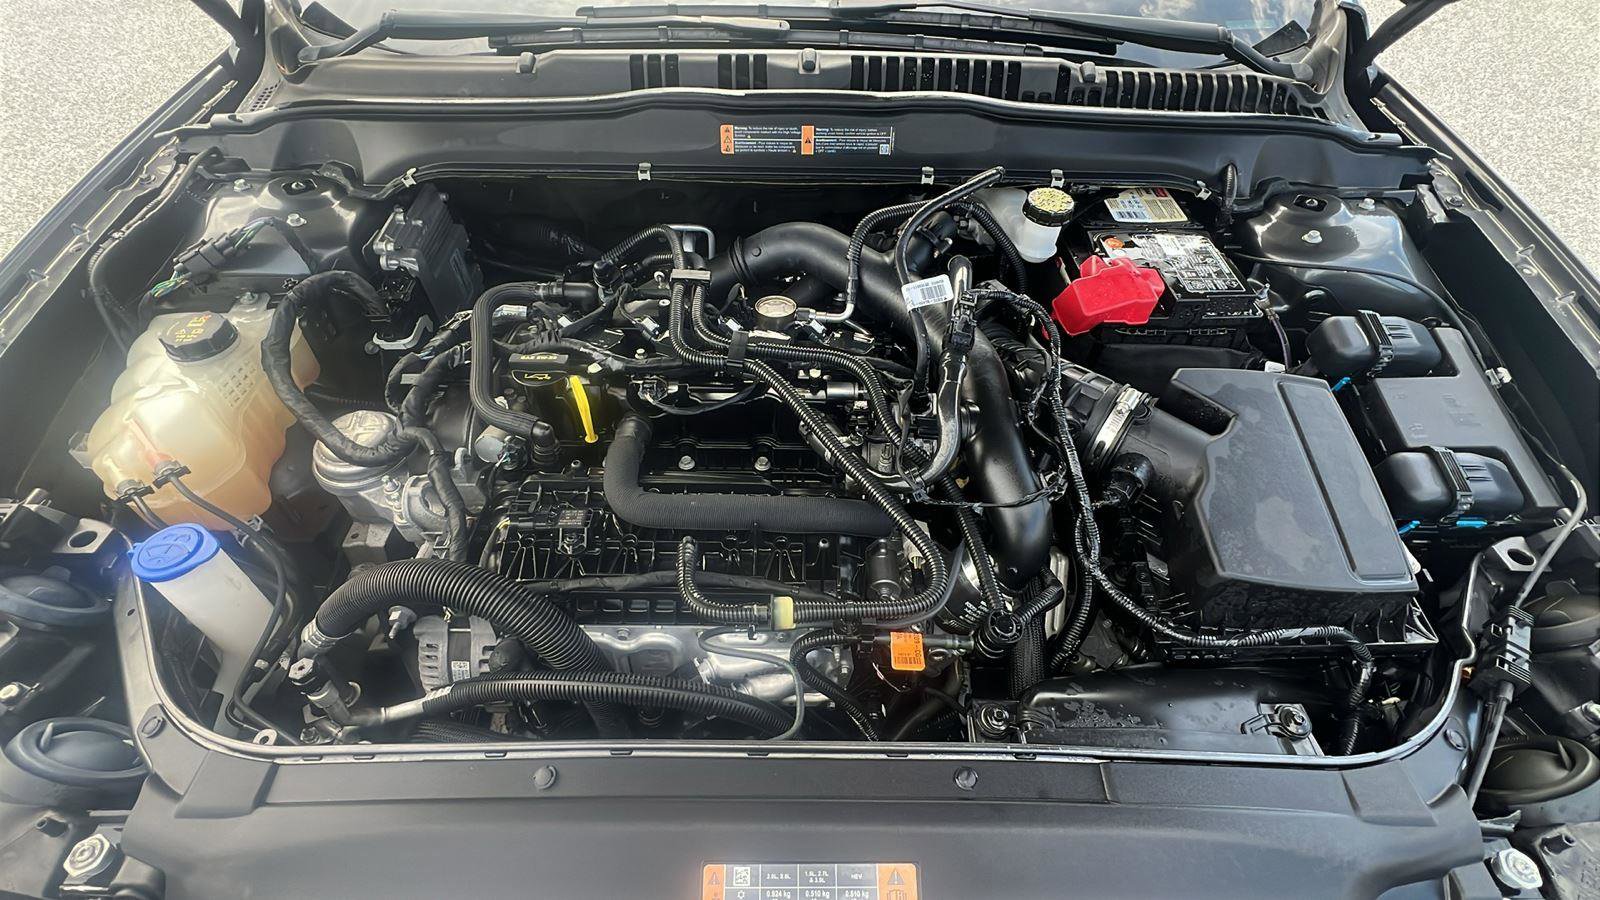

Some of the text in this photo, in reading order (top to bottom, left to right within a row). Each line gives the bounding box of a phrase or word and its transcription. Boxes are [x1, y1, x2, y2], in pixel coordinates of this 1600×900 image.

[783, 890, 791, 899] kg
[822, 890, 830, 899] kg
[862, 890, 869, 899] kg
